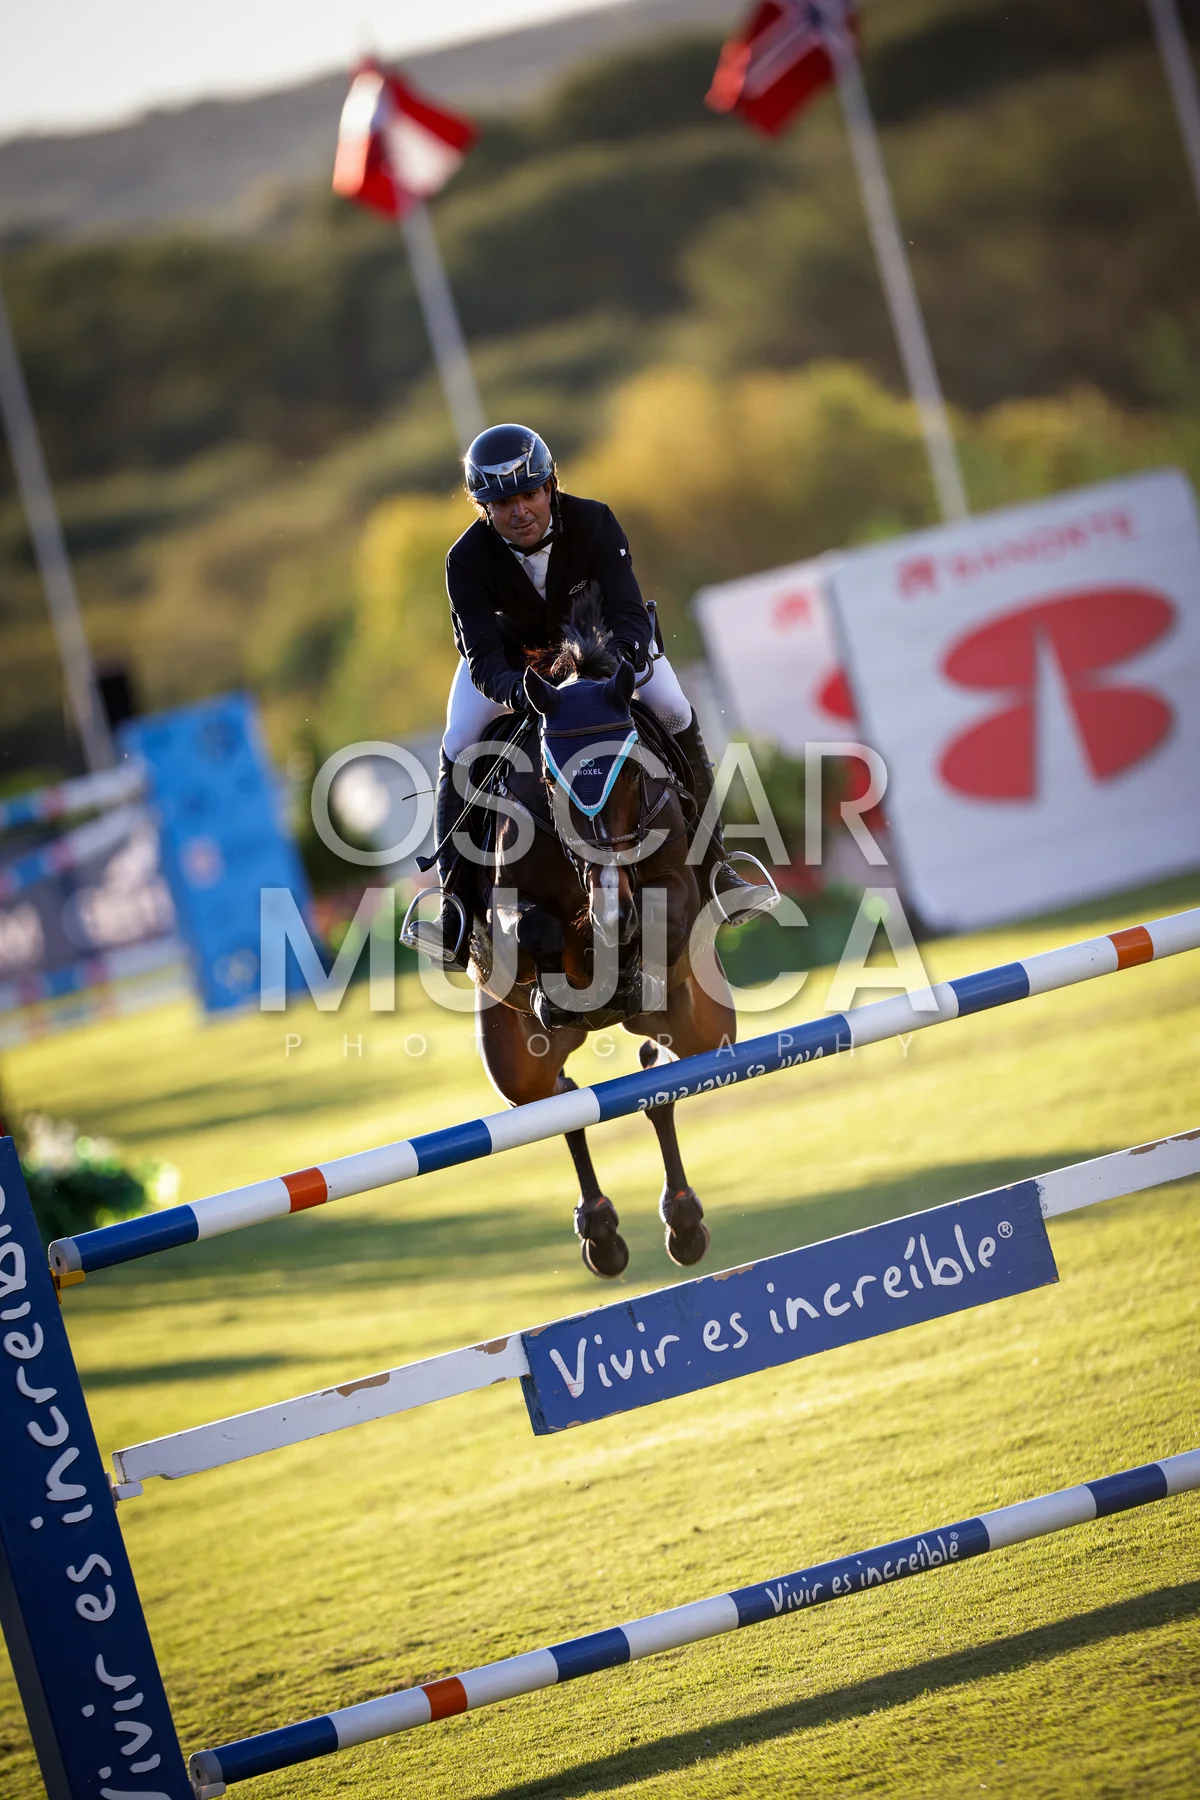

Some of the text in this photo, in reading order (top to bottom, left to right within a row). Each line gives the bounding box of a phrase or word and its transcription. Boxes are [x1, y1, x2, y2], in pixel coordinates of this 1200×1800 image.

[572, 768, 603, 776] BROXEL
[549, 1322, 681, 1399] Vivir
[702, 1311, 749, 1353] es
[67, 1553, 116, 1622] es
[765, 1577, 824, 1613] Vivir
[832, 1572, 852, 1595] es
